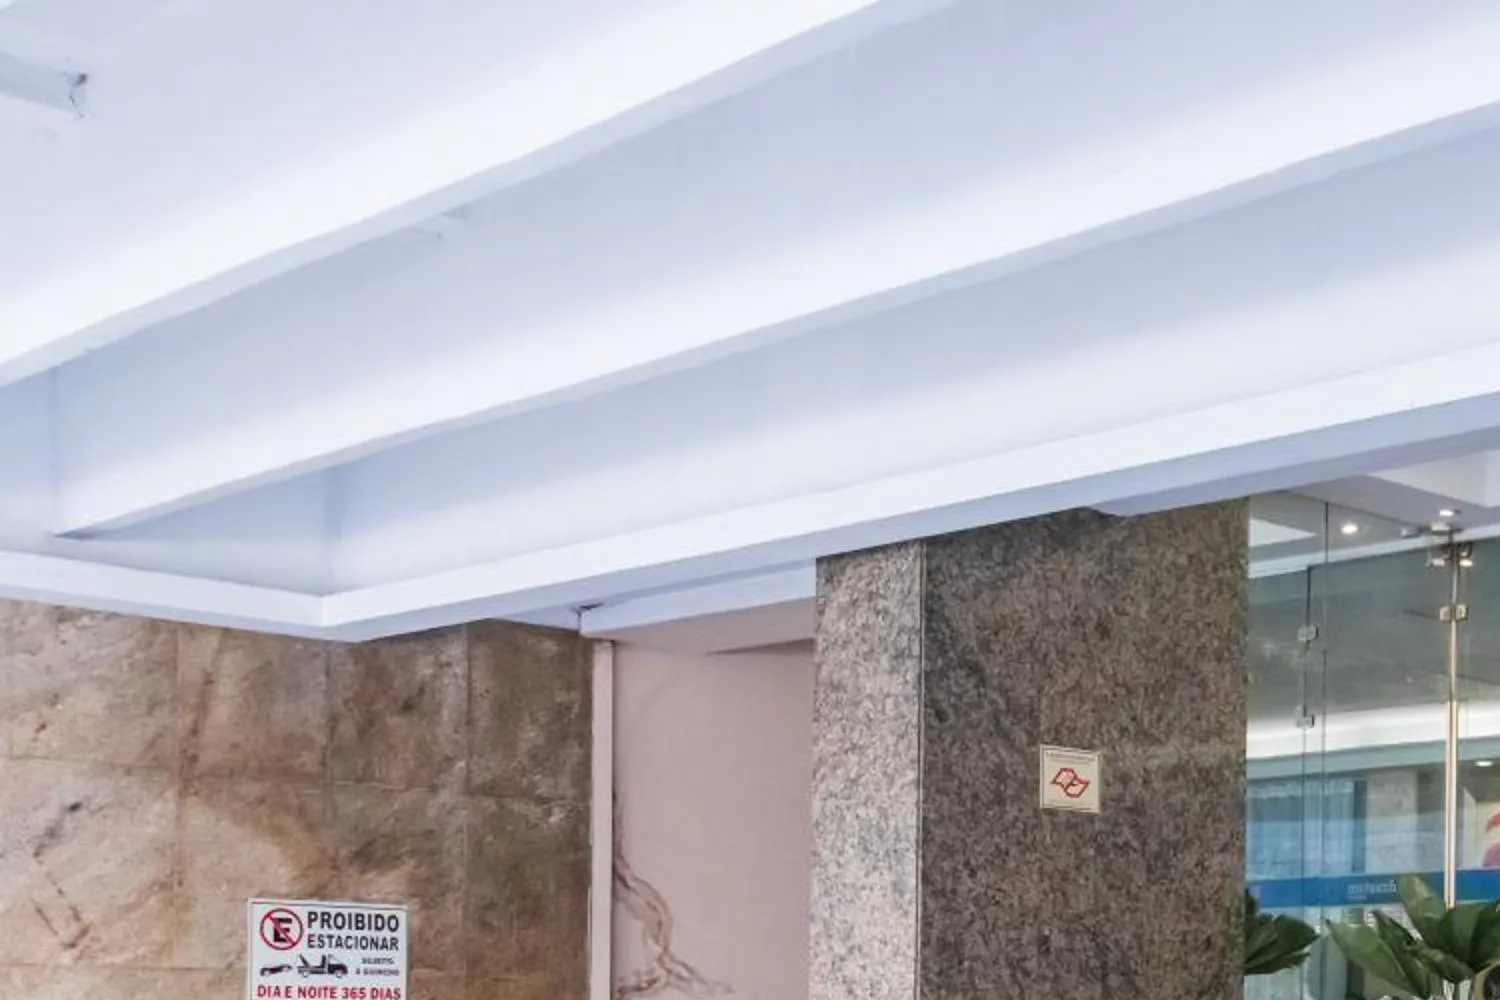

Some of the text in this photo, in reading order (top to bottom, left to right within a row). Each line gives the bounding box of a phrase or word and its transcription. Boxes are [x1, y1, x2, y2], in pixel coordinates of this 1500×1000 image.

[307, 911, 399, 932] PROIBIDO
[307, 934, 399, 951] ESTACIONAR
[257, 984, 401, 1000] DIA E NOITE 365 DIAS
